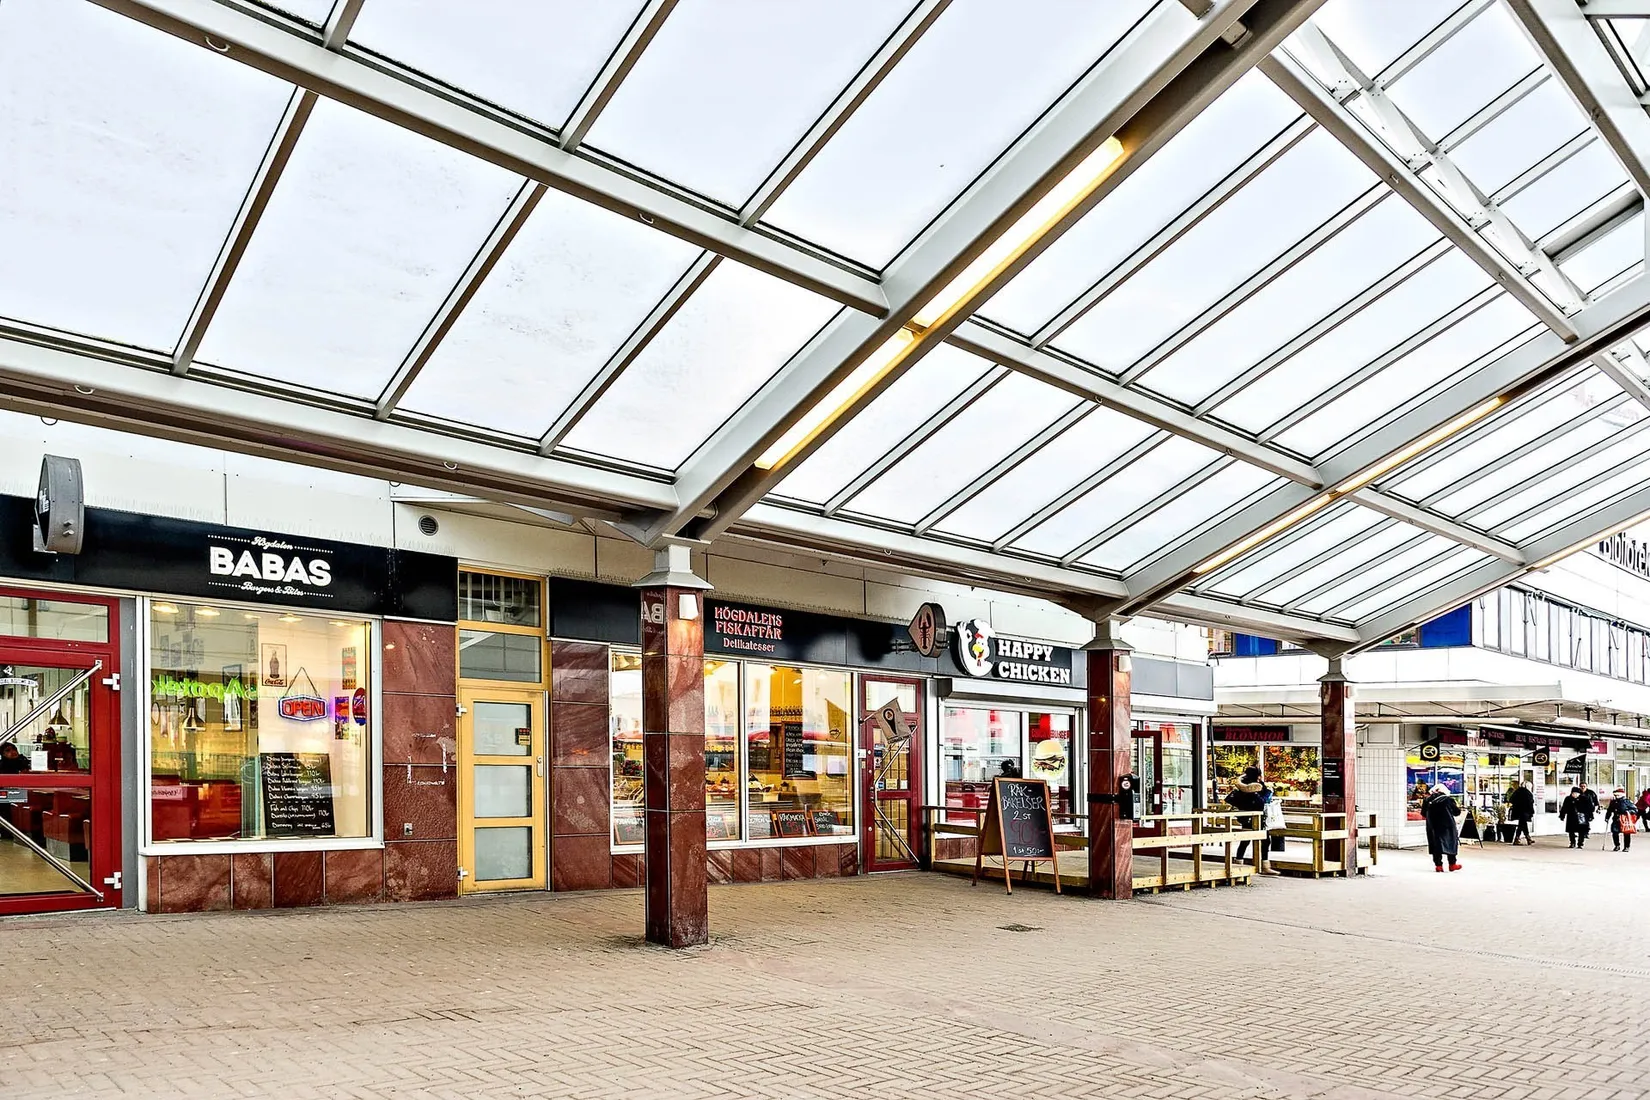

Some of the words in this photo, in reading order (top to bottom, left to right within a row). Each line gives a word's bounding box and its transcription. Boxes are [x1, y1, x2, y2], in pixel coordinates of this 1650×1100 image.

[210, 546, 332, 587] BABAS
[240, 581, 275, 595] Burgers
[275, 586, 283, 594] &
[282, 585, 304, 596] Bites
[714, 606, 783, 627] HÖGDALENS
[715, 620, 782, 640] FISKAFFÄR
[723, 637, 776, 652] Delikatesser
[998, 639, 1053, 662] HAPPY
[998, 661, 1070, 684] CHICKEN
[283, 700, 324, 717] OPEN
[1225, 731, 1285, 740] BLOMMOR
[1002, 795, 1046, 811] BAKELSER
[1013, 811, 1021, 820] 2
